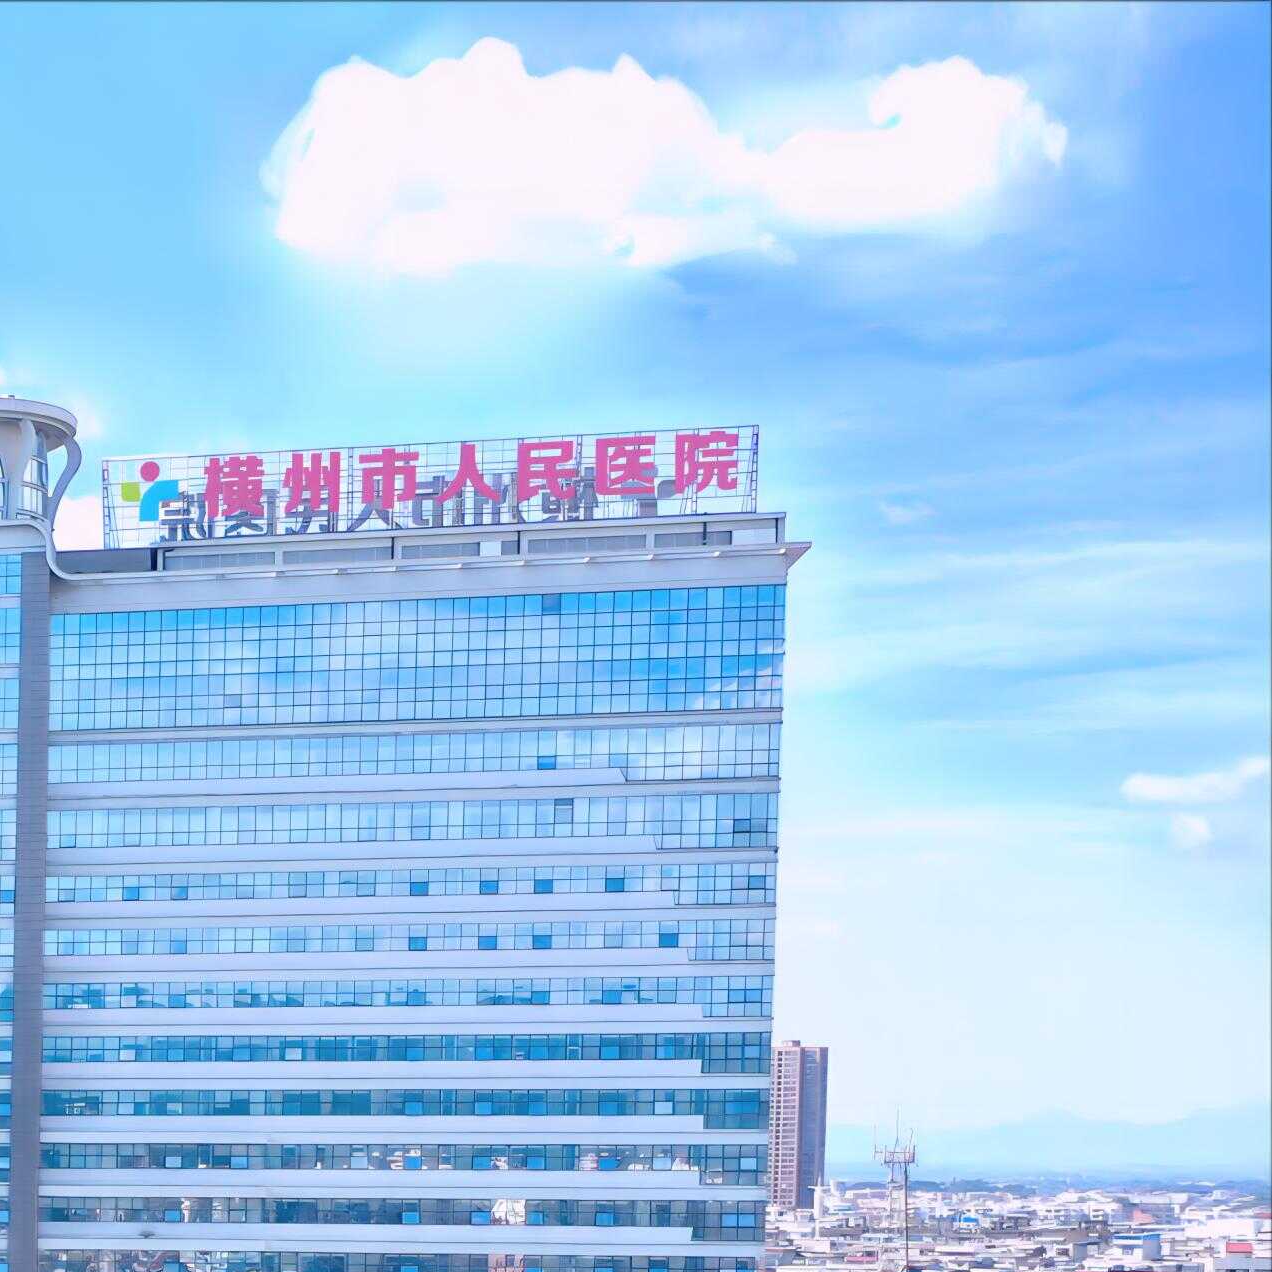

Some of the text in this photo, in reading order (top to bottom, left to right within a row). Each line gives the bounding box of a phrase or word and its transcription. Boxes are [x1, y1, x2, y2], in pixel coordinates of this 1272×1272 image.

[203, 430, 738, 518] 横州市人民医院
